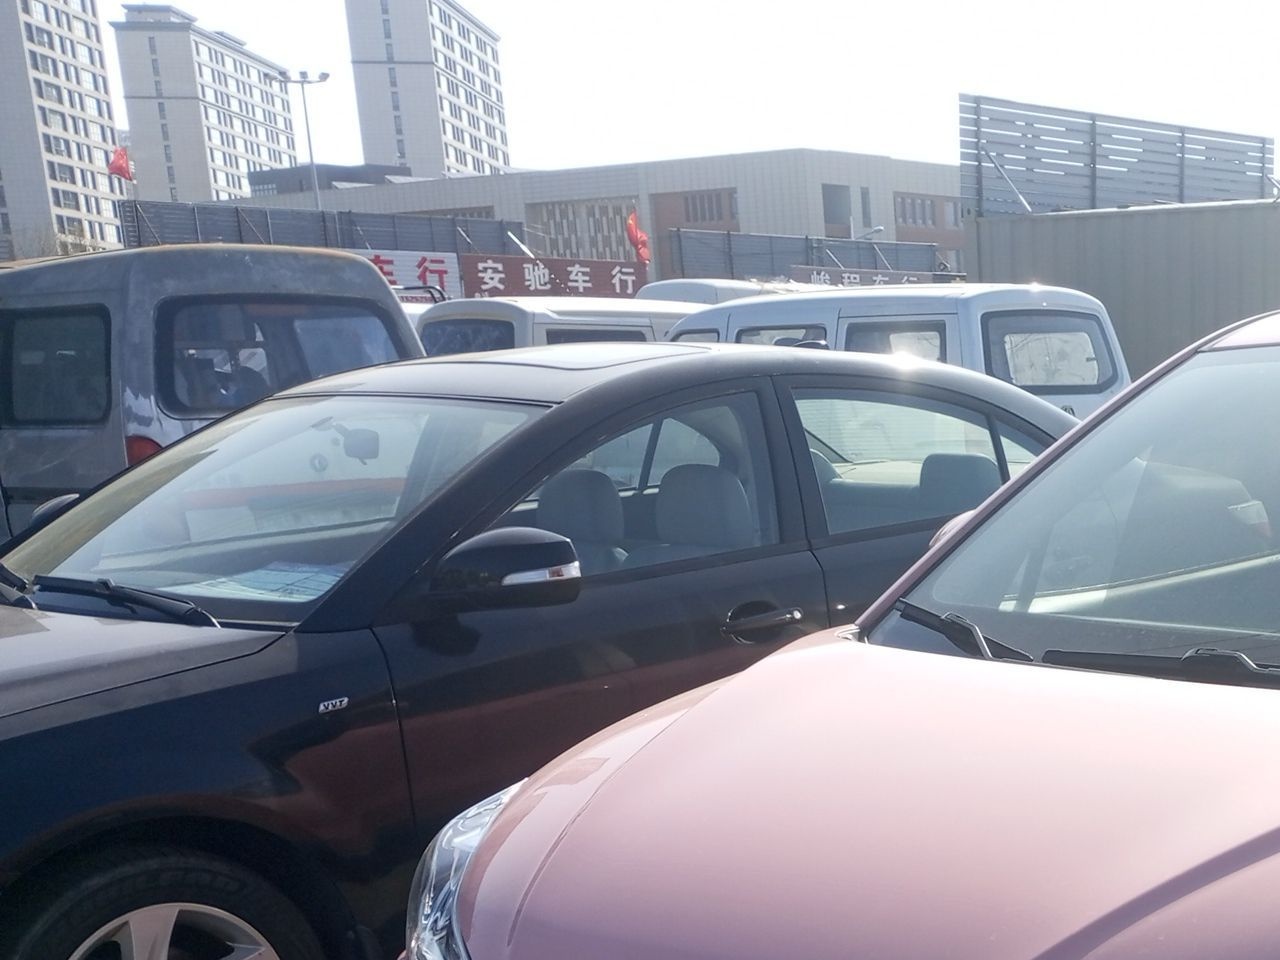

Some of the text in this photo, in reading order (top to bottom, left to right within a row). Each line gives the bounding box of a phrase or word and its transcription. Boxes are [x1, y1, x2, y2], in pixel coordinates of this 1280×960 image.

[371, 255, 449, 292] 车行
[477, 259, 637, 295] 安驰车行
[322, 698, 346, 711] VVT
